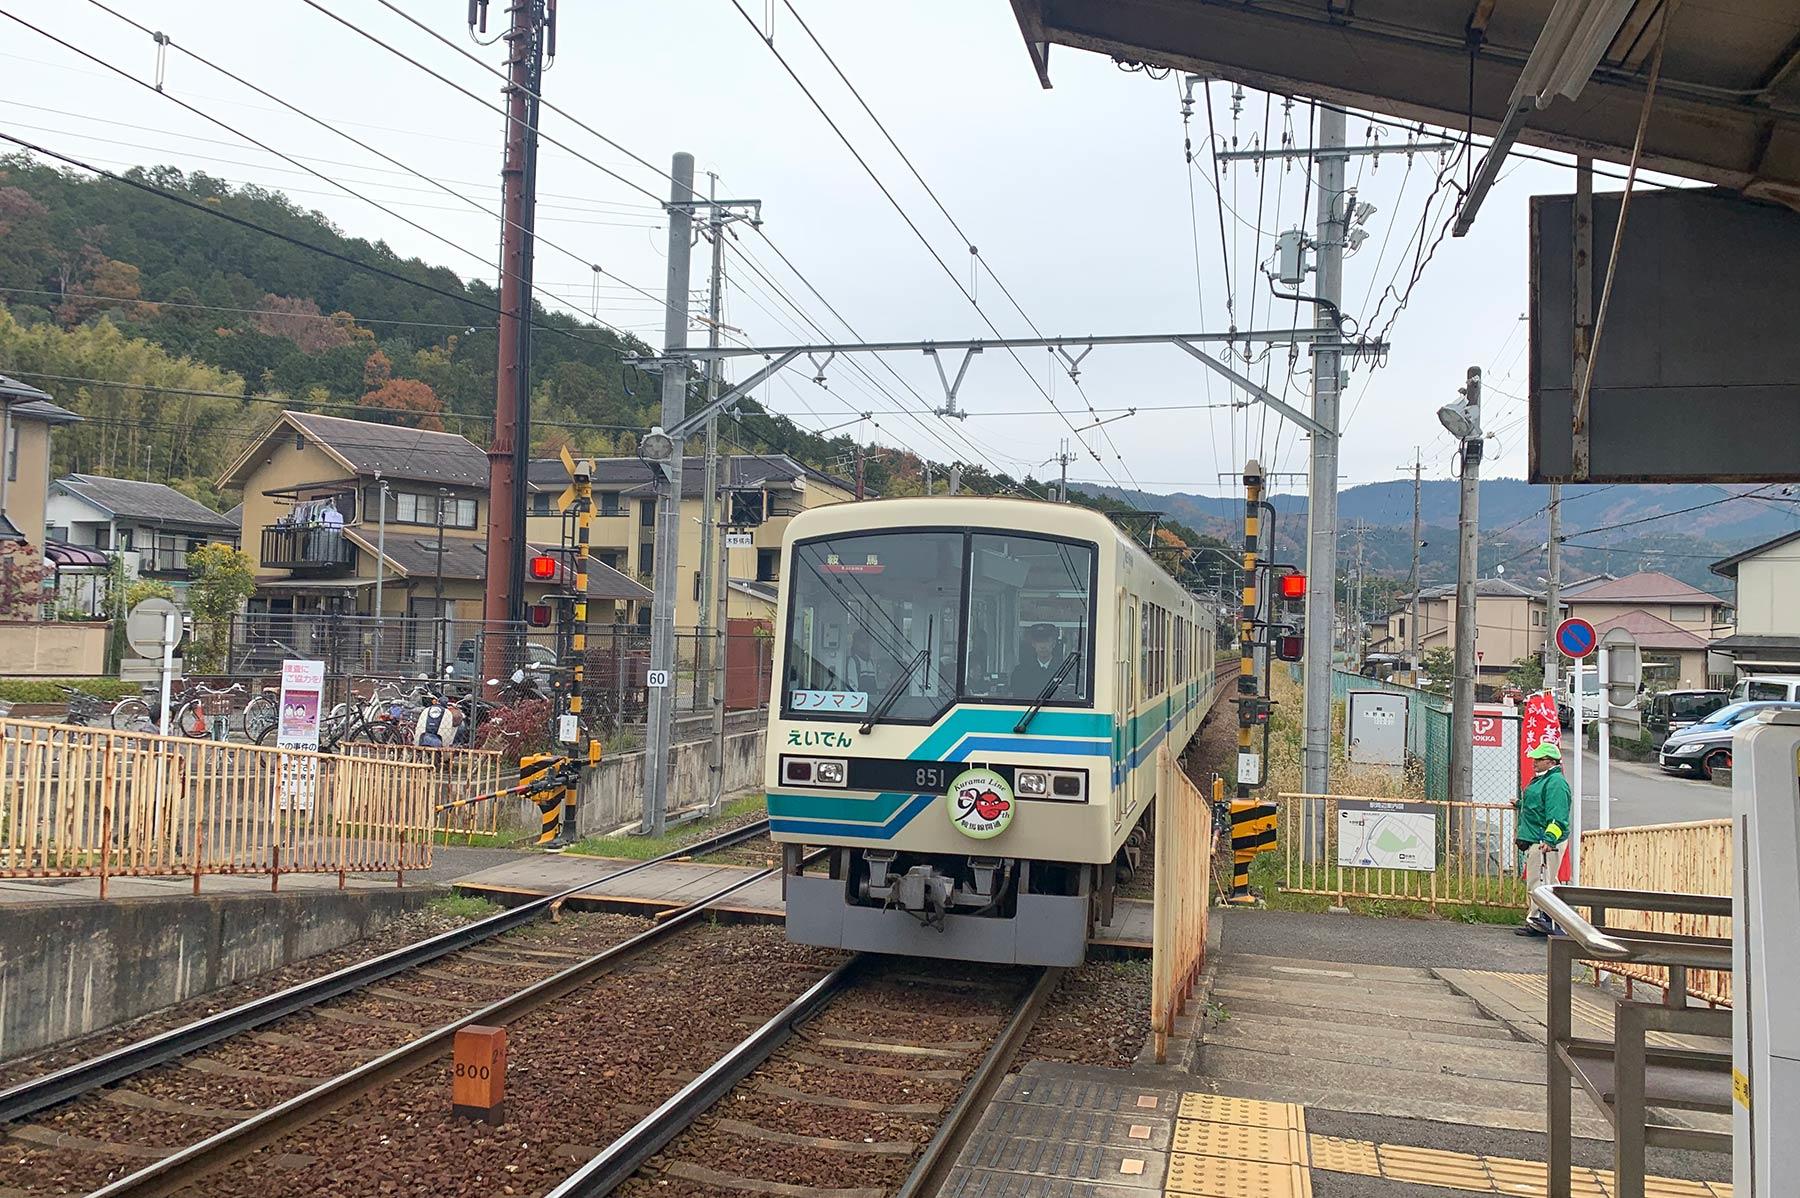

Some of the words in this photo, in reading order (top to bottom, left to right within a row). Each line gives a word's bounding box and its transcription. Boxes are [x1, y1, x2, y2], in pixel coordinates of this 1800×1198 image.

[649, 672, 665, 685] 60
[794, 692, 865, 709] ワンマン
[788, 730, 852, 748] えいでん
[916, 768, 945, 787] 851
[954, 778, 986, 792] Kurama
[988, 778, 1006, 791] Line
[455, 1062, 490, 1080] 800
